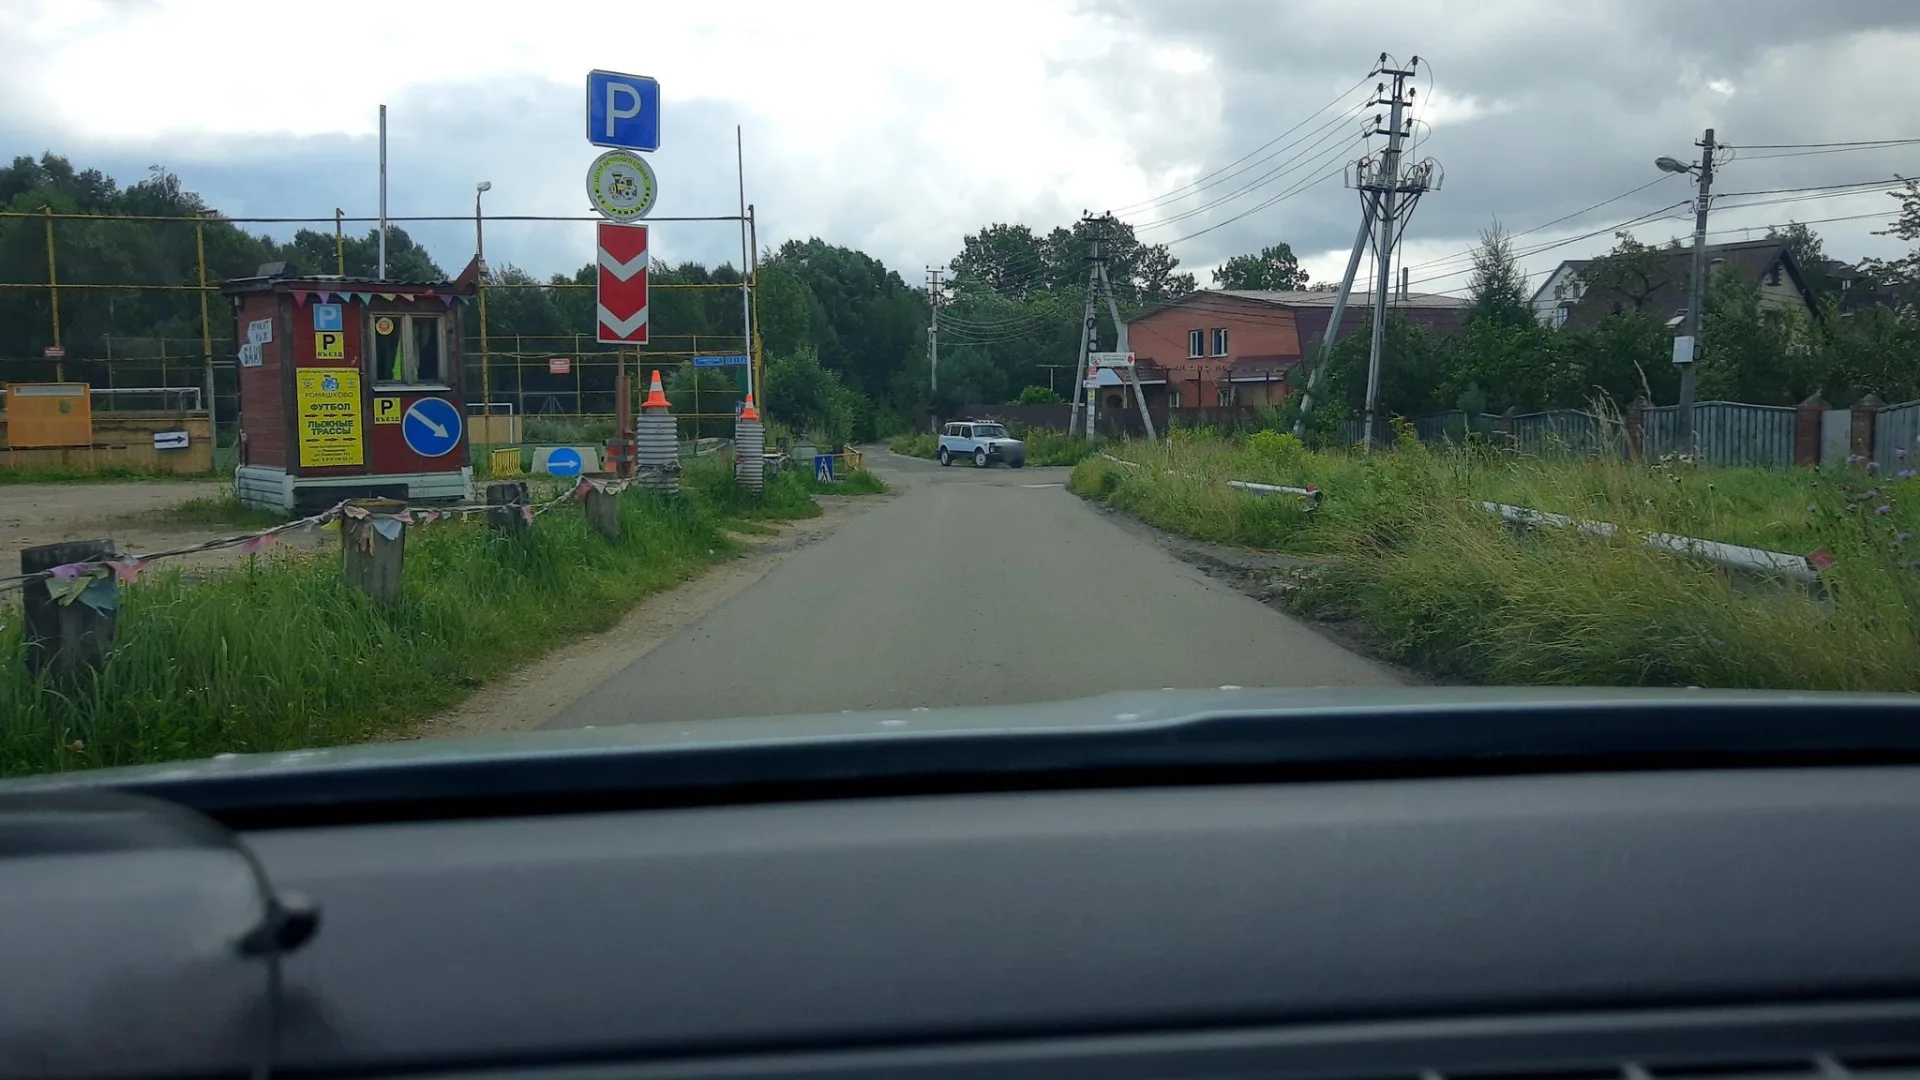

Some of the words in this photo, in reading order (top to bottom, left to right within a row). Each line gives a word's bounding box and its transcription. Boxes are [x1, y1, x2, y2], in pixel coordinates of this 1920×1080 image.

[606, 81, 642, 137] P
[612, 186, 651, 215] РОМАШКОВО
[319, 306, 337, 328] P
[323, 334, 336, 350] P
[381, 400, 394, 415] P
[308, 420, 354, 428] ЛЫЖНЫЕ
